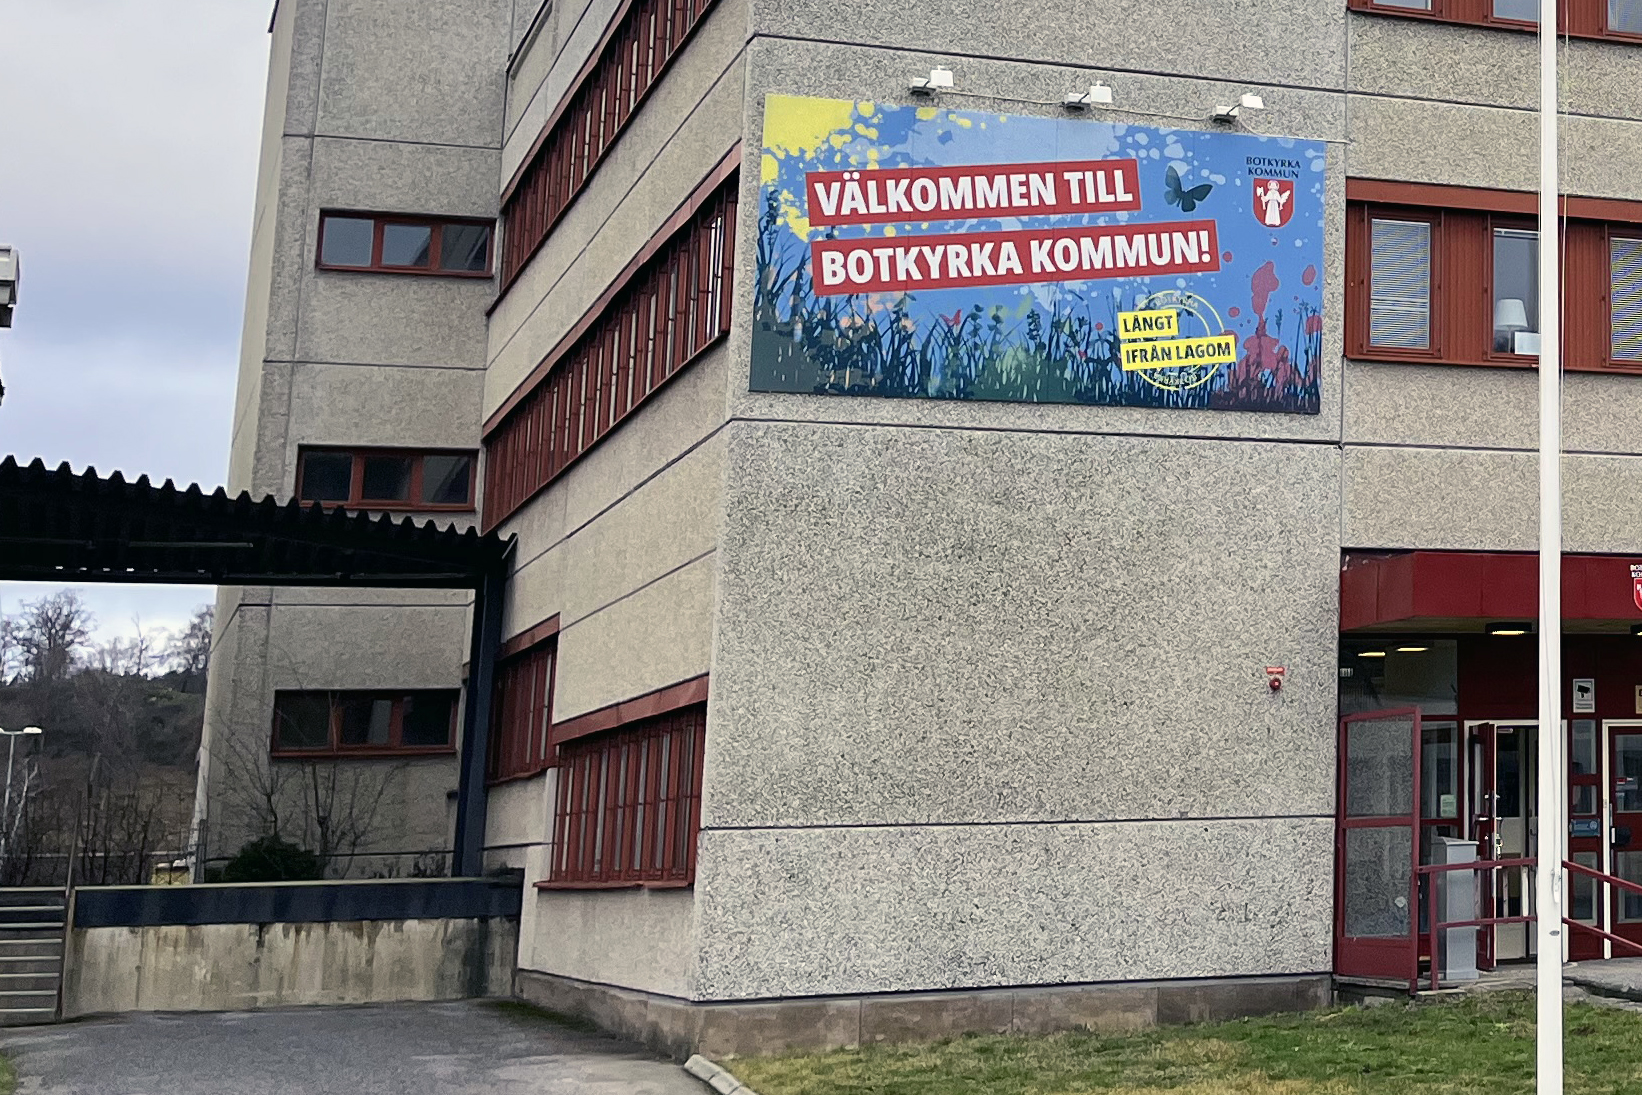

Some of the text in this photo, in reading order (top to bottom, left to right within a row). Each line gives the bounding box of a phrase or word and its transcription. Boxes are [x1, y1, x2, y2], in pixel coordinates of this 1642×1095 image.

[1245, 156, 1301, 169] BOTKYRKA
[1247, 166, 1299, 179] KOMMUN
[814, 169, 1133, 217] VÄLKOMMEN TILL
[821, 230, 1211, 286] BOTKYRKA KOMMUN!
[1122, 314, 1173, 333] LÅNGT
[1125, 341, 1232, 364] IFRÅN LAGOM
